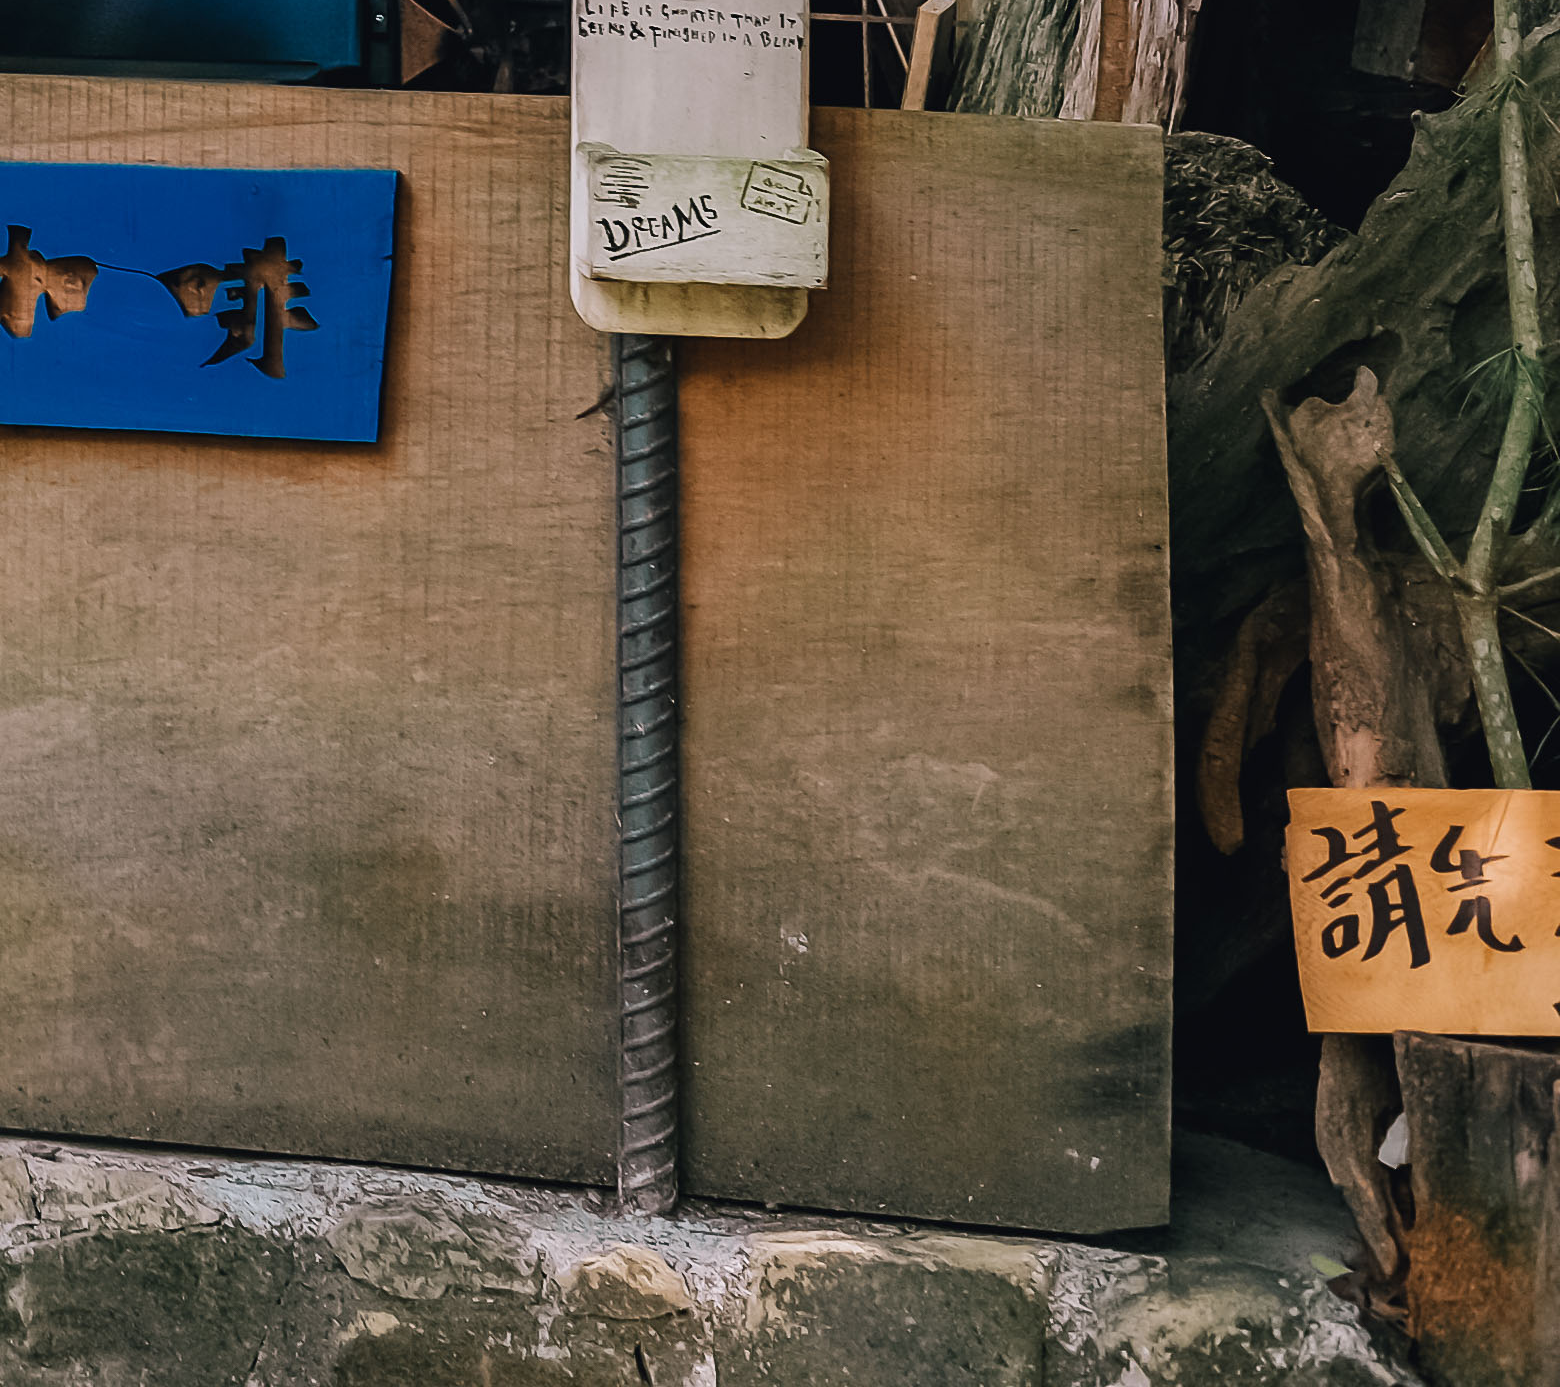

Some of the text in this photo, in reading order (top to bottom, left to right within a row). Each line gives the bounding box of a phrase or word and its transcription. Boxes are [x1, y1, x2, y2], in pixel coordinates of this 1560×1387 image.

[639, 4, 652, 16] IS
[629, 20, 646, 40] &
[595, 194, 718, 252] DREAMS
[1302, 800, 1560, 969] 請先
